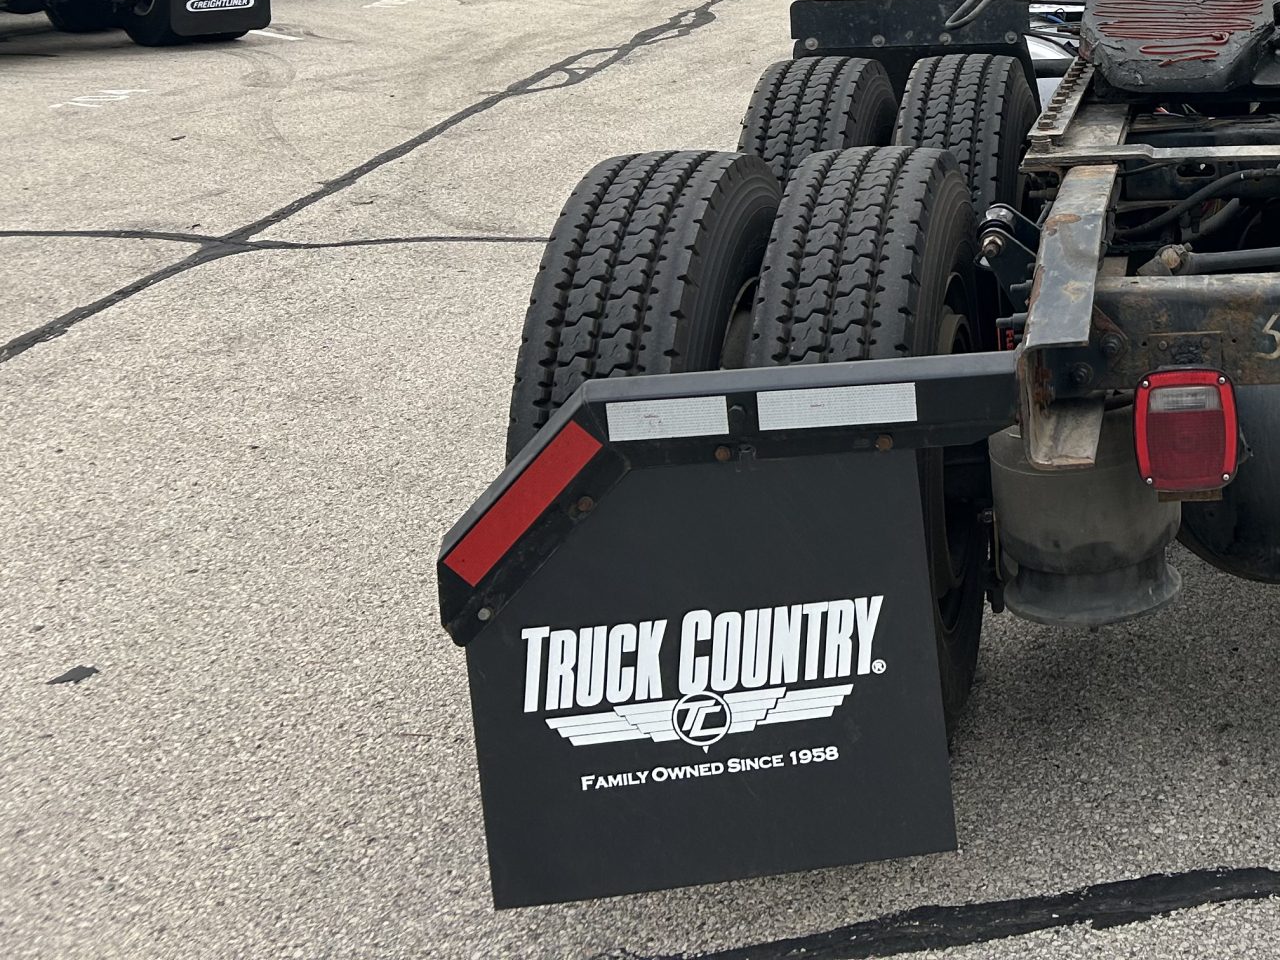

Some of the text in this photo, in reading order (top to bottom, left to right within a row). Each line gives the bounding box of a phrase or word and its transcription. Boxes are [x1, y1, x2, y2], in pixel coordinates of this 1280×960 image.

[521, 619, 667, 713] TRUCK
[581, 746, 839, 790] FAMILY OWNED SINCE 1958
